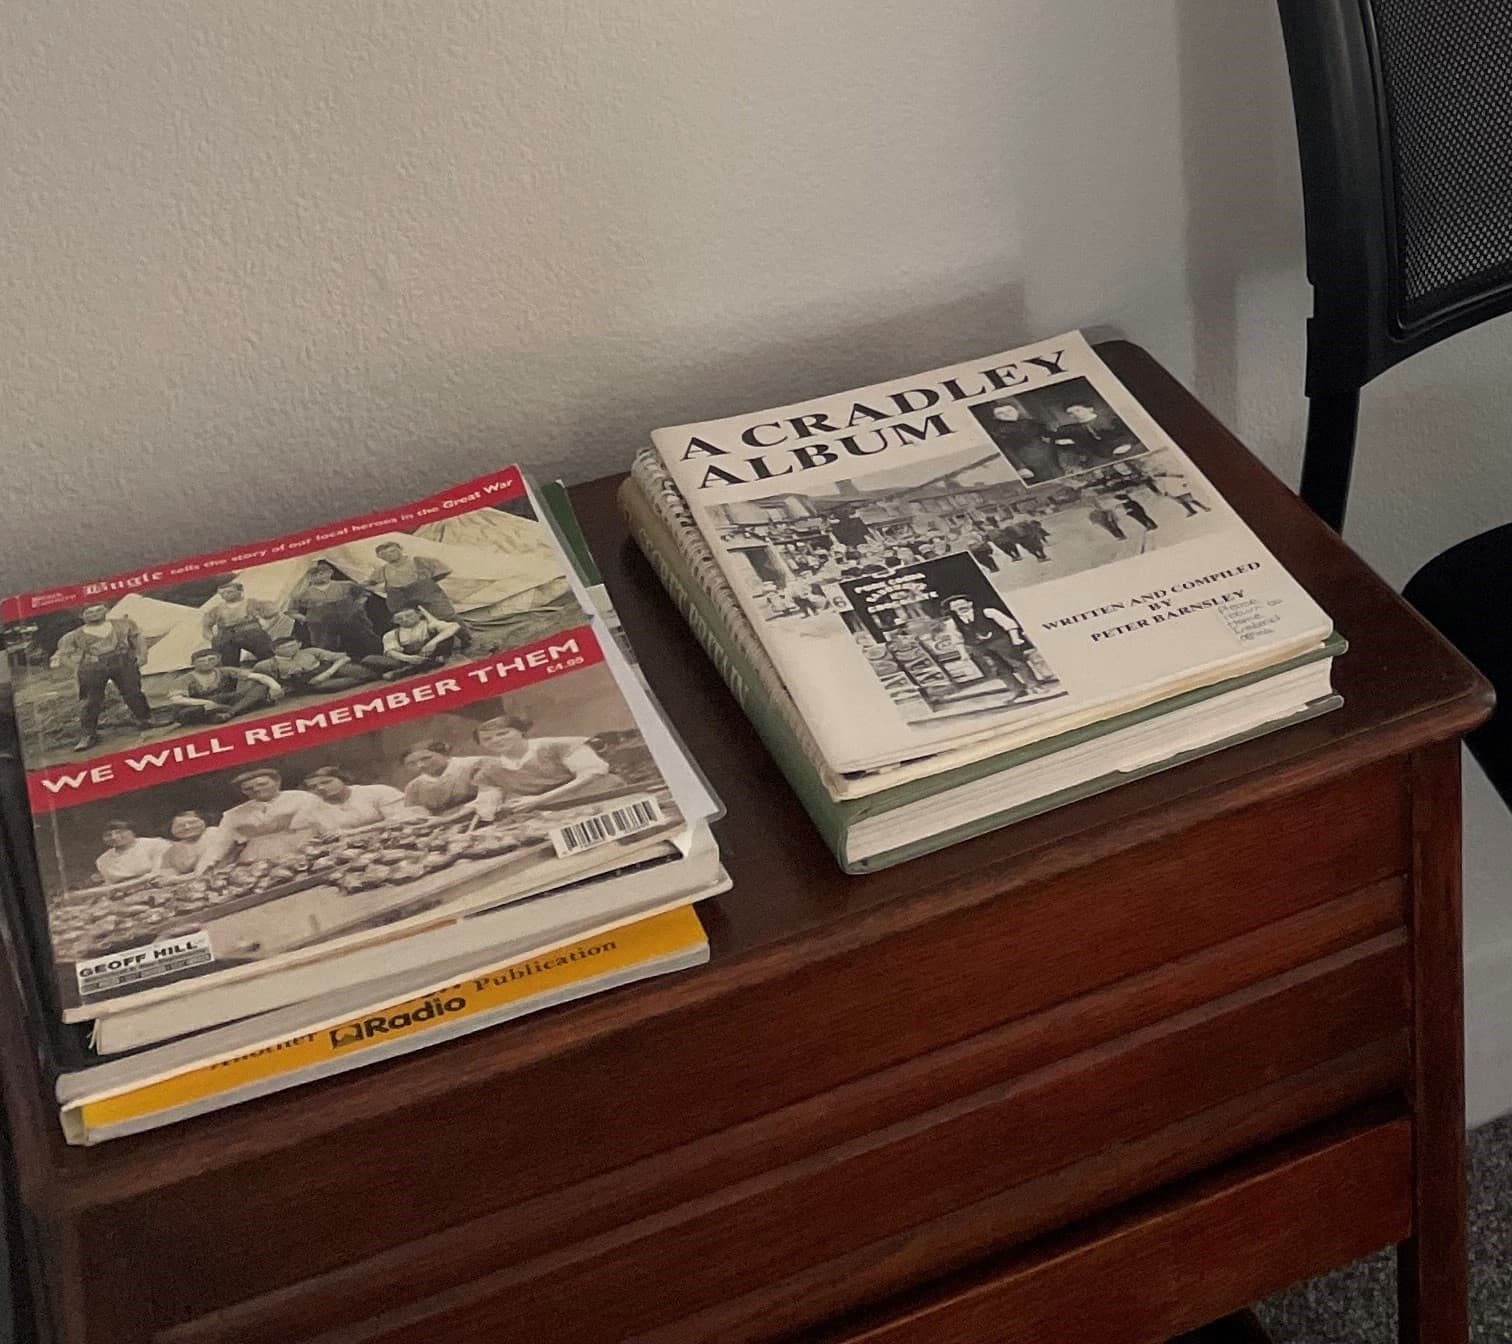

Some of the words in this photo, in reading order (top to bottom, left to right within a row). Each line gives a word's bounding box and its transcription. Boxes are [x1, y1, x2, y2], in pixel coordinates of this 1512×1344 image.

[680, 435, 730, 461] A
[740, 350, 1069, 449] CRADLEY
[697, 414, 958, 488] ALBUM
[442, 491, 481, 508] Great
[483, 479, 513, 494] War
[1042, 601, 1125, 631] WRITTEN
[1130, 590, 1167, 607] AND
[1171, 562, 1260, 593] COMPILED
[1091, 618, 1151, 642] PETER
[1152, 590, 1244, 624] BARNSLEY
[1147, 599, 1172, 611] BY
[41, 764, 115, 794] WE
[124, 738, 235, 771] WILL
[246, 675, 462, 747] REMEMBER
[468, 639, 581, 684] THEM
[79, 953, 146, 978] GEOFF
[153, 942, 198, 959] HILL
[475, 941, 617, 991] Publication
[364, 995, 466, 1037] Radio
